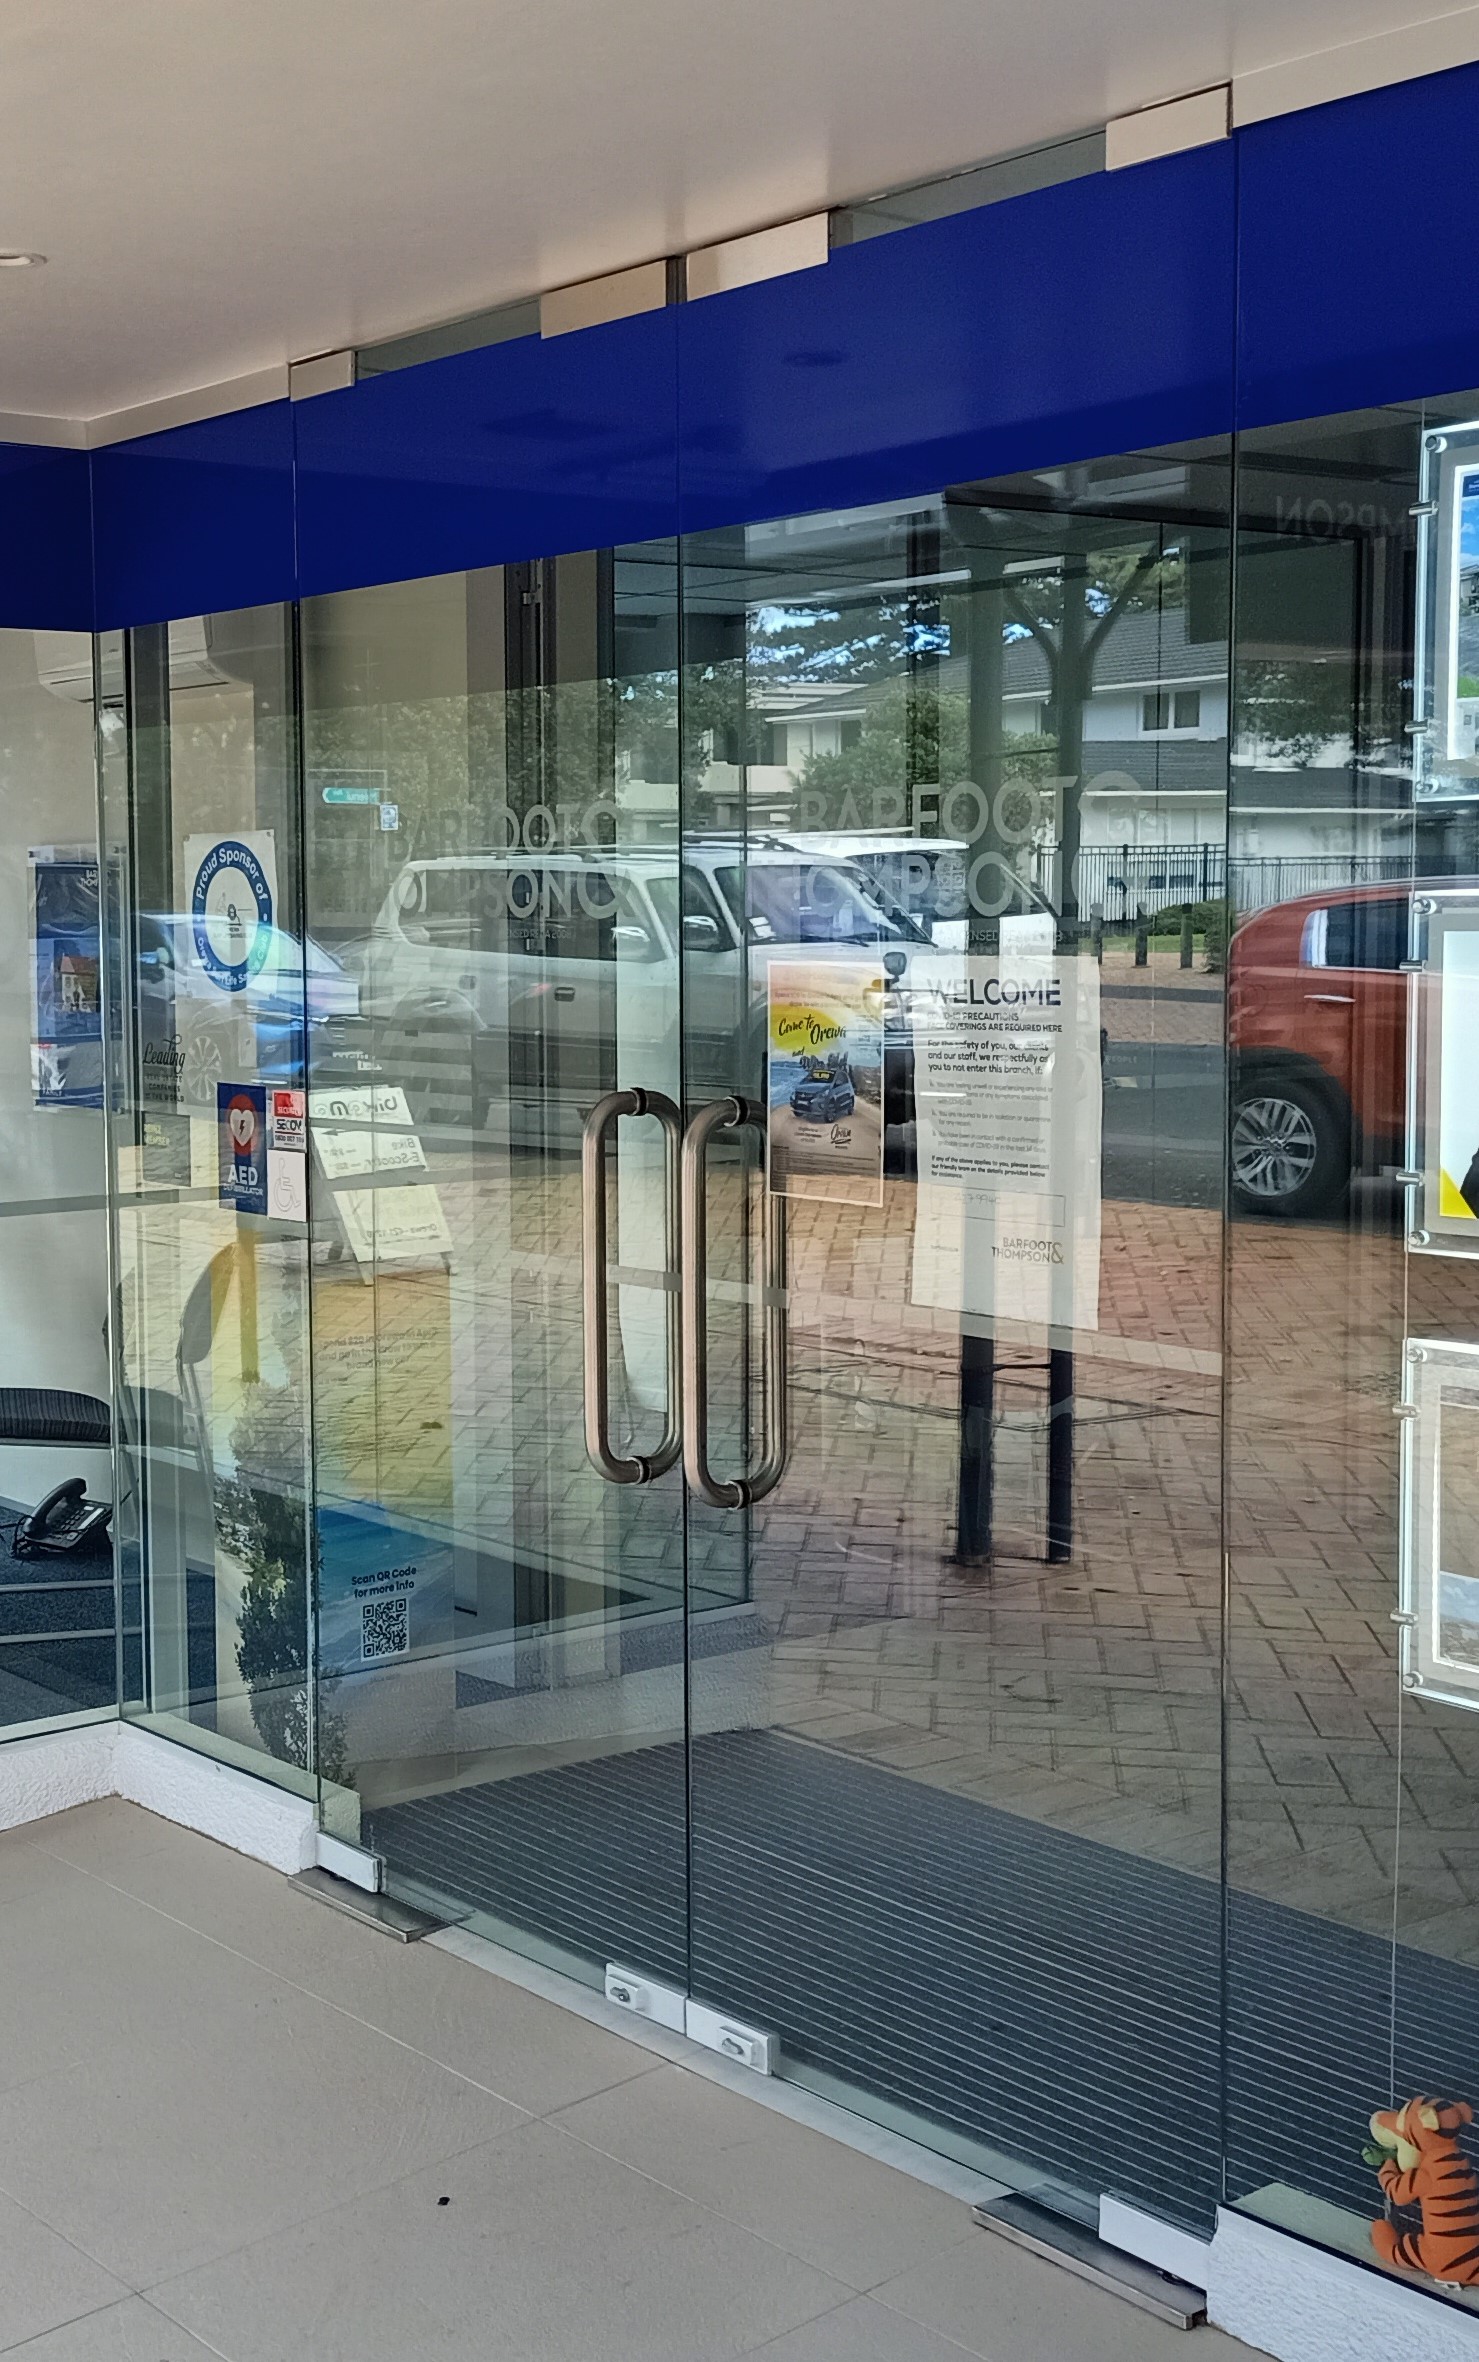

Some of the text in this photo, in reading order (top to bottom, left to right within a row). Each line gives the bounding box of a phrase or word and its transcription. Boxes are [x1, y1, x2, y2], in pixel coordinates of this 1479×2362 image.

[801, 775, 1079, 849] BARFOOT
[384, 801, 581, 863] BAROOT
[195, 847, 269, 900] Proud Sponsor of
[927, 978, 1061, 1006] WELCOME
[778, 1014, 815, 1036] Come to
[945, 1022, 987, 1031] COVERINGS
[988, 1023, 1003, 1031] ARE
[1004, 1024, 1042, 1032] REQUIRED
[1043, 1024, 1063, 1033] HERE
[962, 1012, 1019, 1021] PRECAUTIONS
[810, 1023, 847, 1045] Orewa
[143, 1033, 187, 1074] Leading
[980, 1040, 989, 1050] of
[990, 1042, 1008, 1052] you,
[927, 1052, 942, 1060] and
[957, 1051, 978, 1062] staff,
[992, 1053, 1037, 1065] reectfully
[928, 1064, 942, 1073] you
[952, 1064, 965, 1072] not
[966, 1065, 987, 1073] enter
[988, 1064, 1002, 1073] this
[1004, 1066, 1034, 1076] branch,
[228, 1163, 258, 1186] AED
[991, 1246, 1050, 1263] THOMPSON
[1003, 1237, 1064, 1264] BARFOOT &
[351, 1566, 417, 1586] Scan QR Code
[353, 1579, 415, 1599] for more info
